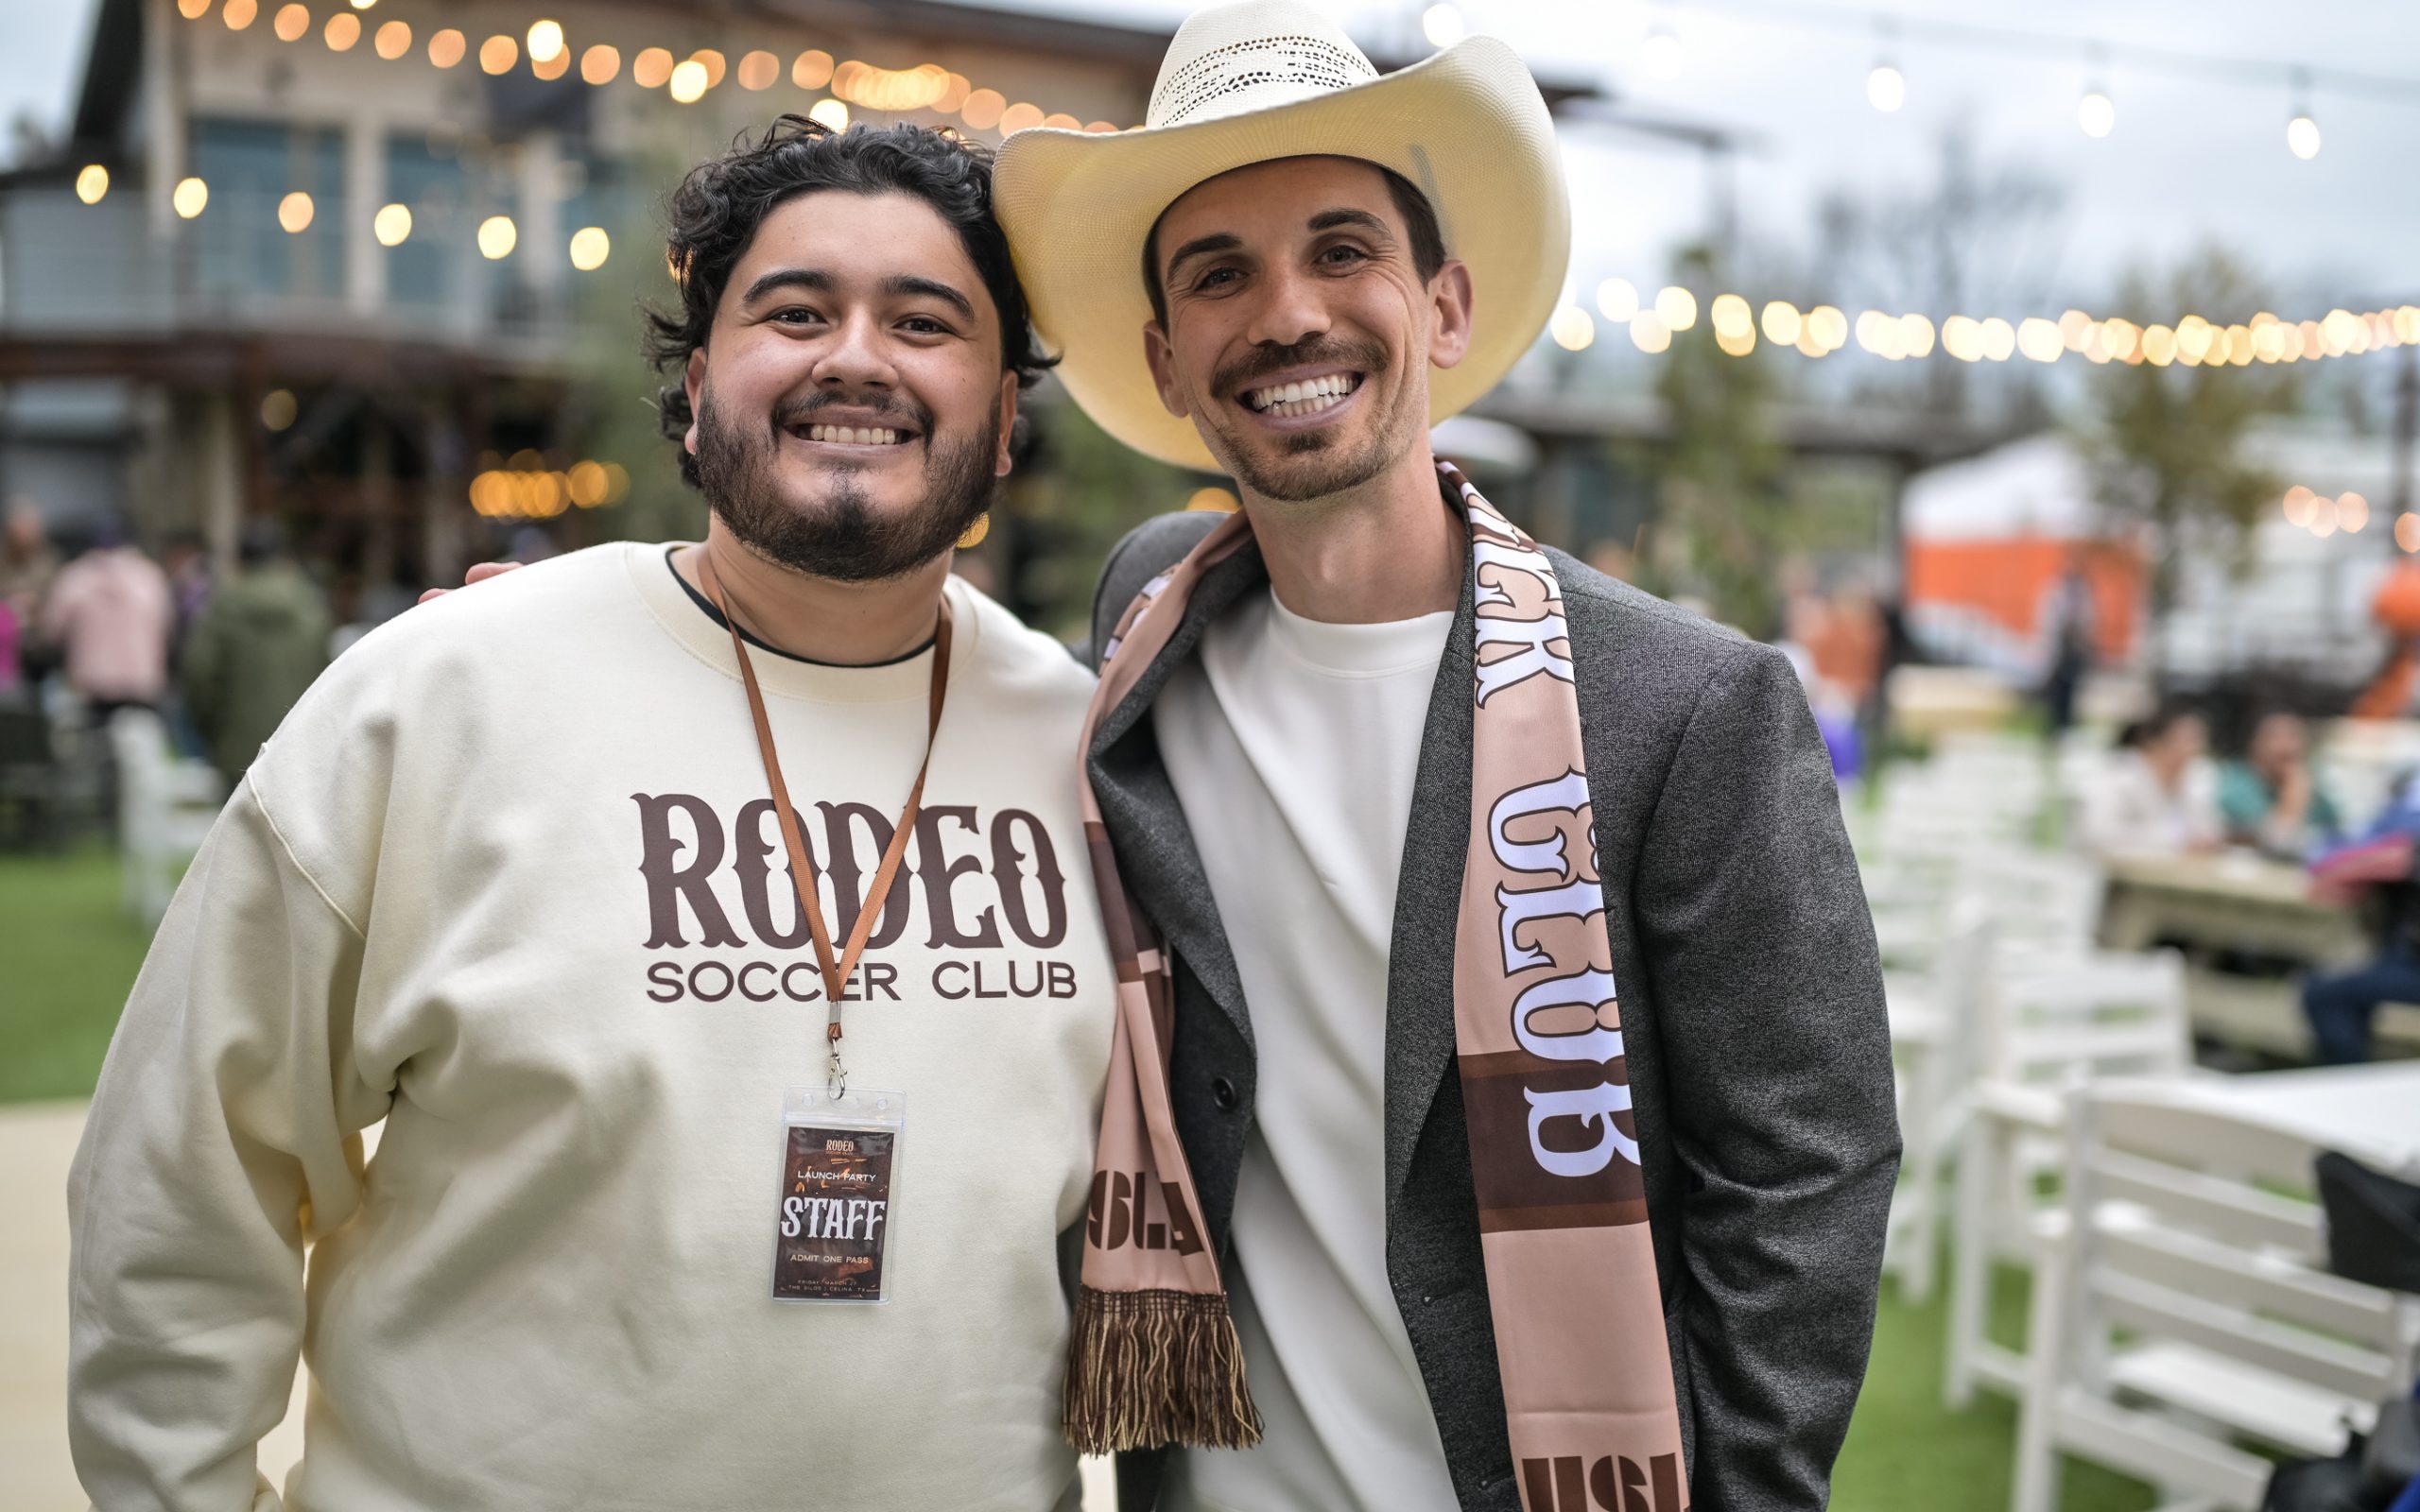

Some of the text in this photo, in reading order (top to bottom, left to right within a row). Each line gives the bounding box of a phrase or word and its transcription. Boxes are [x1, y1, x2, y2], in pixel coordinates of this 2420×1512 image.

[629, 792, 1067, 950] RODEO
[931, 960, 1078, 1000] CLUB
[825, 1139, 855, 1152] RODEO
[797, 1170, 876, 1182] LAUNCH PARTY
[780, 1196, 887, 1241] STAFF
[790, 1254, 869, 1264] ADMIT ONE PASS
